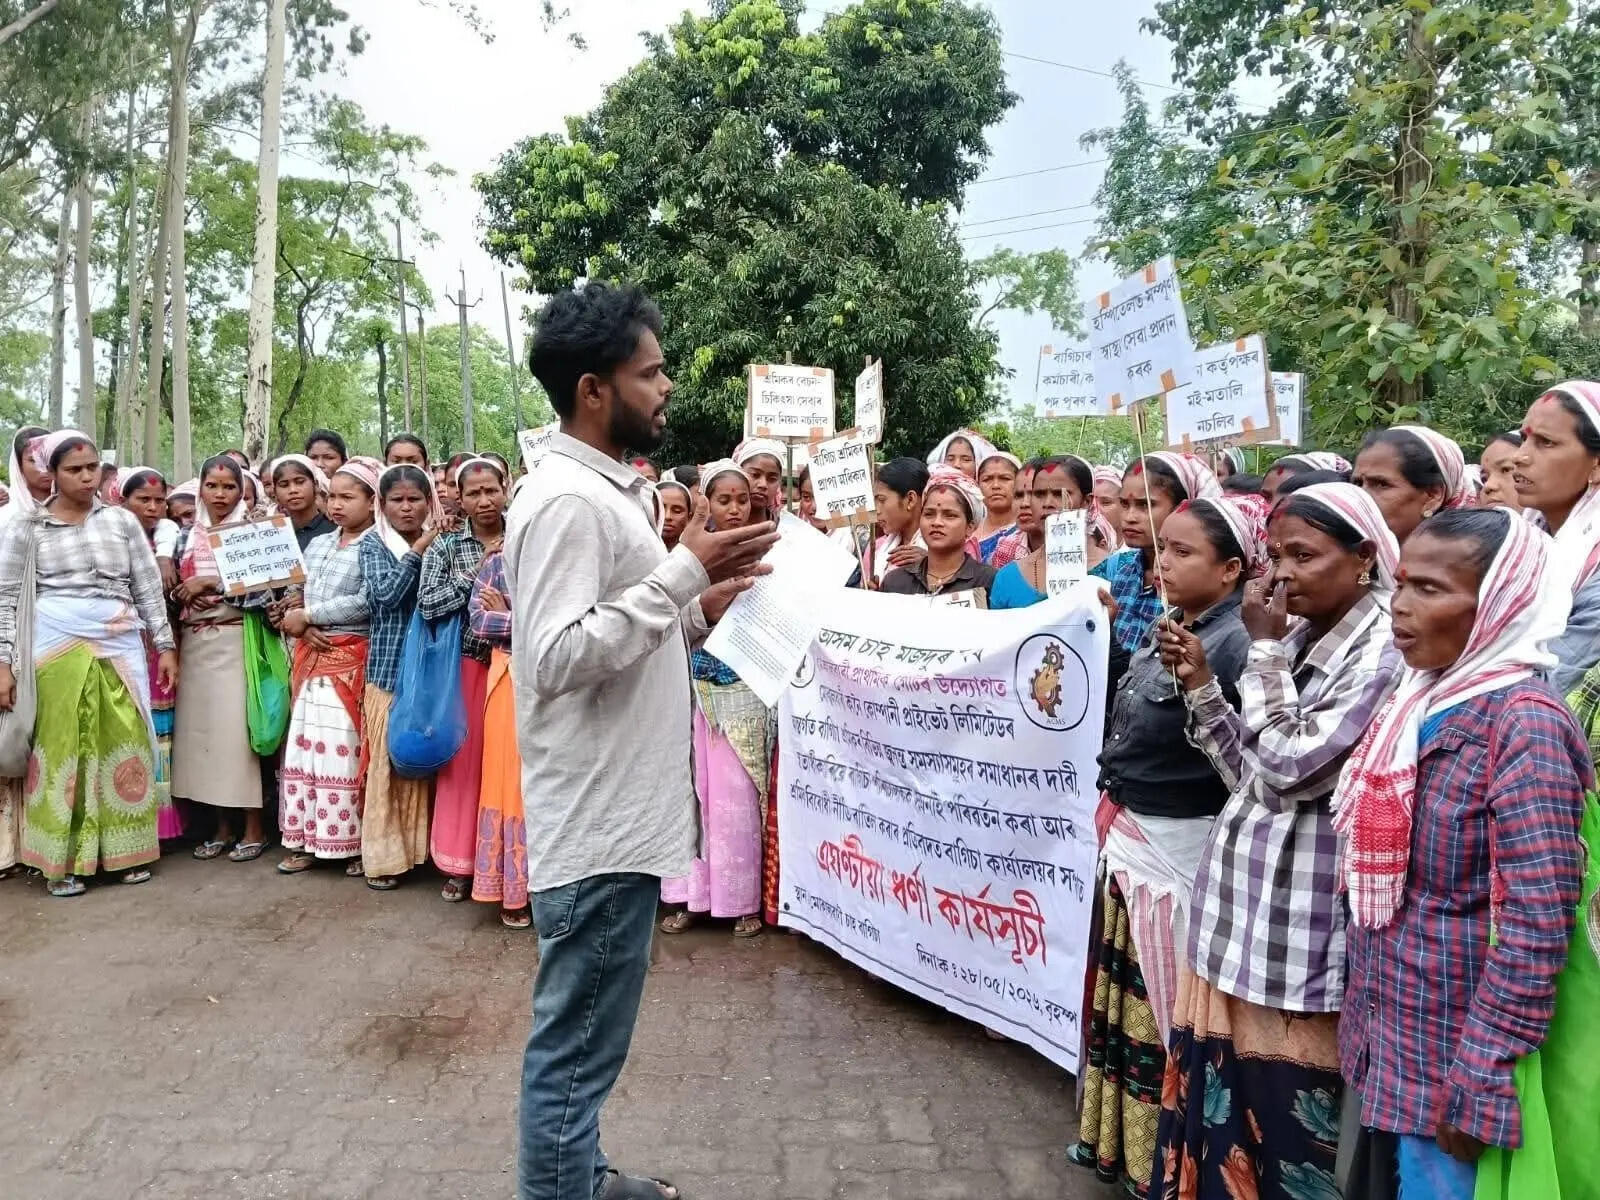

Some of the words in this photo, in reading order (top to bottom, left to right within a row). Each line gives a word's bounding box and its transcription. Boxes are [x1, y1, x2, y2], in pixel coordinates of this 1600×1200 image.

[818, 628, 860, 651] অসম
[859, 638, 895, 662] চাহ
[934, 674, 1007, 698] উদ্যোগত
[903, 702, 949, 733] প্ৰাইভেট
[950, 704, 1015, 740] লিমিটেডৰ
[977, 760, 1040, 791] সমাধানৰ
[1003, 812, 1038, 837] কৰা
[943, 837, 983, 873] বাগিচা
[984, 848, 1055, 887] কাৰ্যালয়ৰ
[933, 882, 1046, 974] কাৰ্যসূচী
